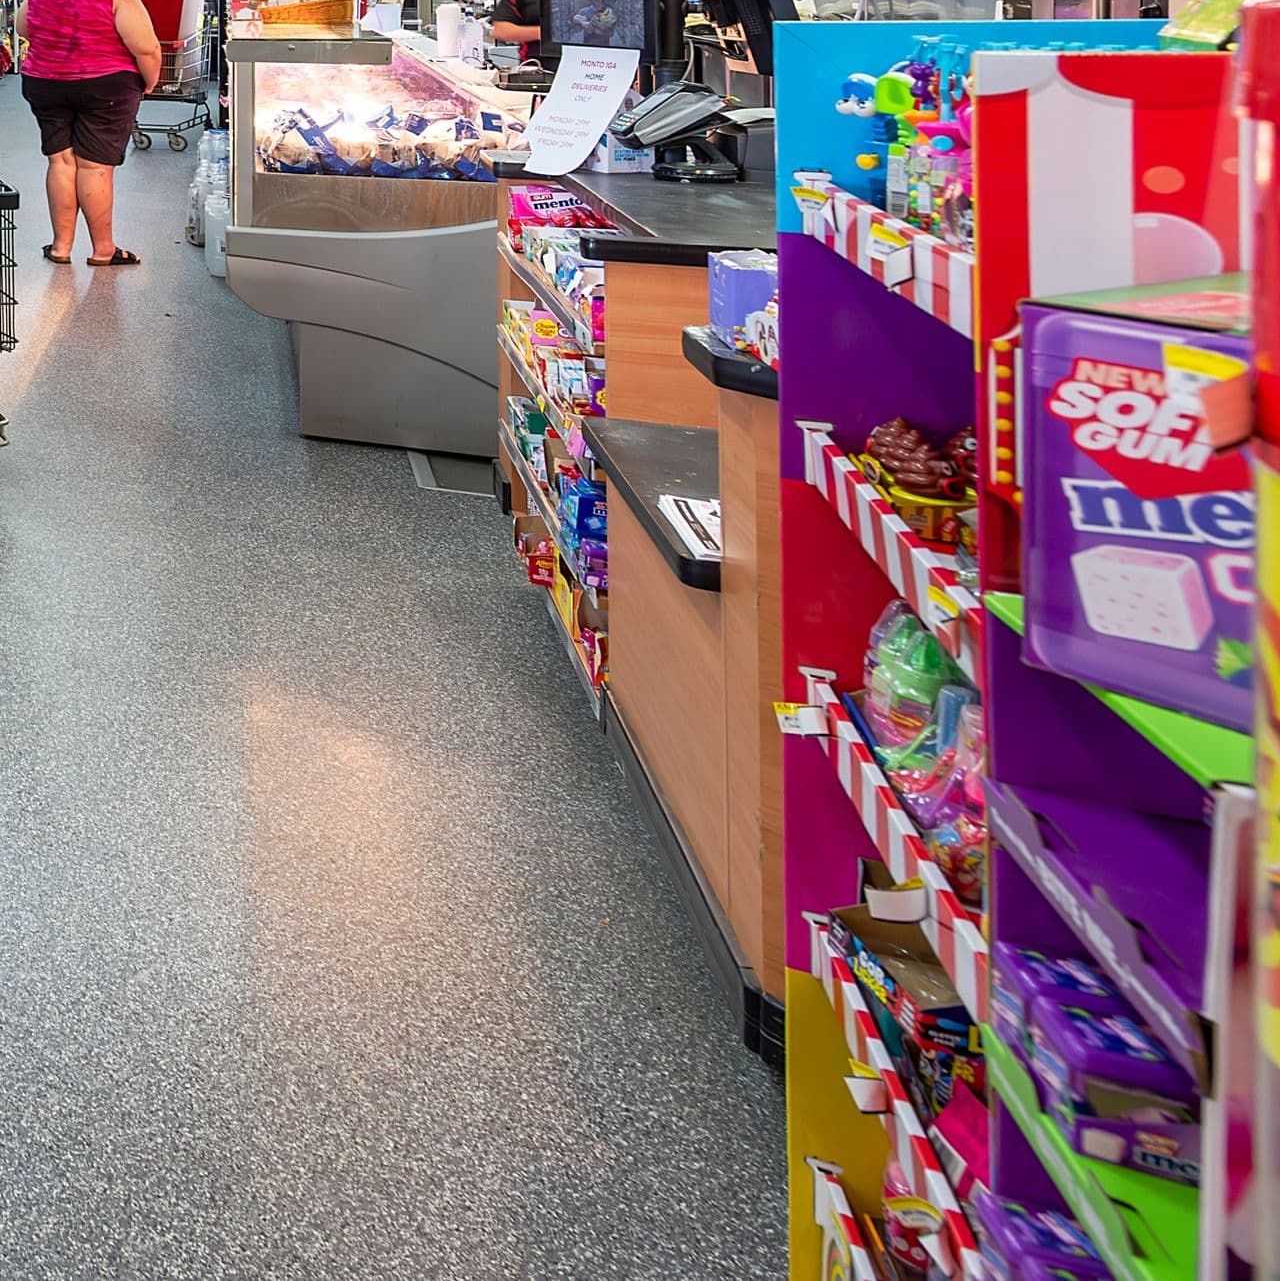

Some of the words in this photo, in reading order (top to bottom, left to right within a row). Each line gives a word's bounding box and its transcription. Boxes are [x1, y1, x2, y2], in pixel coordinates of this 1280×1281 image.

[580, 60, 603, 69] MONTO
[605, 61, 617, 69] IGA
[571, 82, 609, 93] DELIVERIES
[584, 73, 605, 81] HOME
[1073, 359, 1166, 397] NEW
[1049, 380, 1213, 451] SOF
[1073, 421, 1213, 472] GUM
